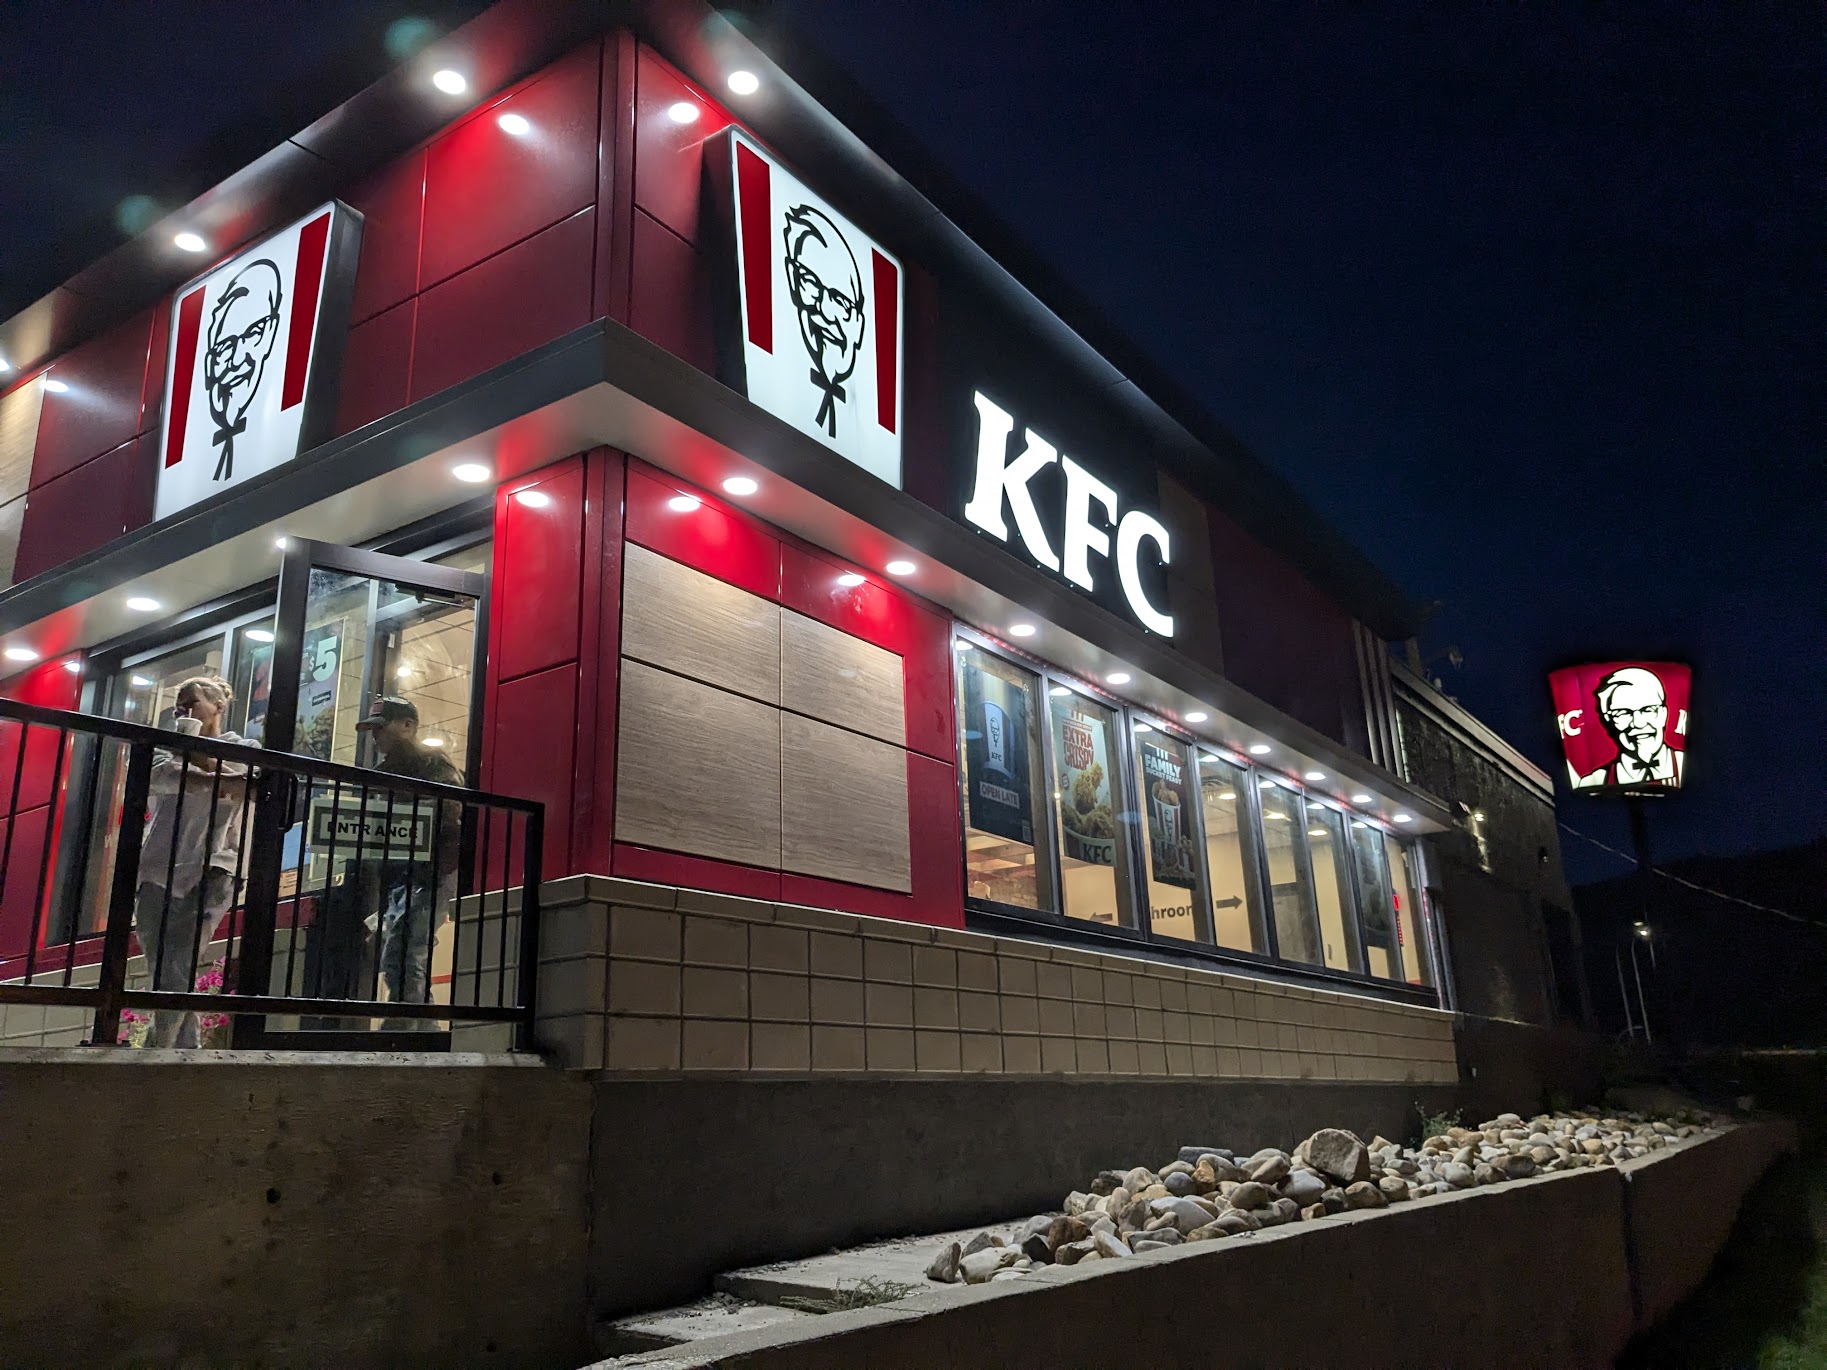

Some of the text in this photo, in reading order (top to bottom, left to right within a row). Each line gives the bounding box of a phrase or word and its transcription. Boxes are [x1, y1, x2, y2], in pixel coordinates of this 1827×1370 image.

[965, 390, 1174, 638] KFC
[1062, 724, 1093, 750] EXTRA
[991, 751, 1002, 762] KFC
[1064, 741, 1094, 771] CRISPY
[1145, 754, 1181, 778] FAMILY
[982, 784, 1018, 806] OPEN LATE
[1083, 843, 1112, 864] KFC
